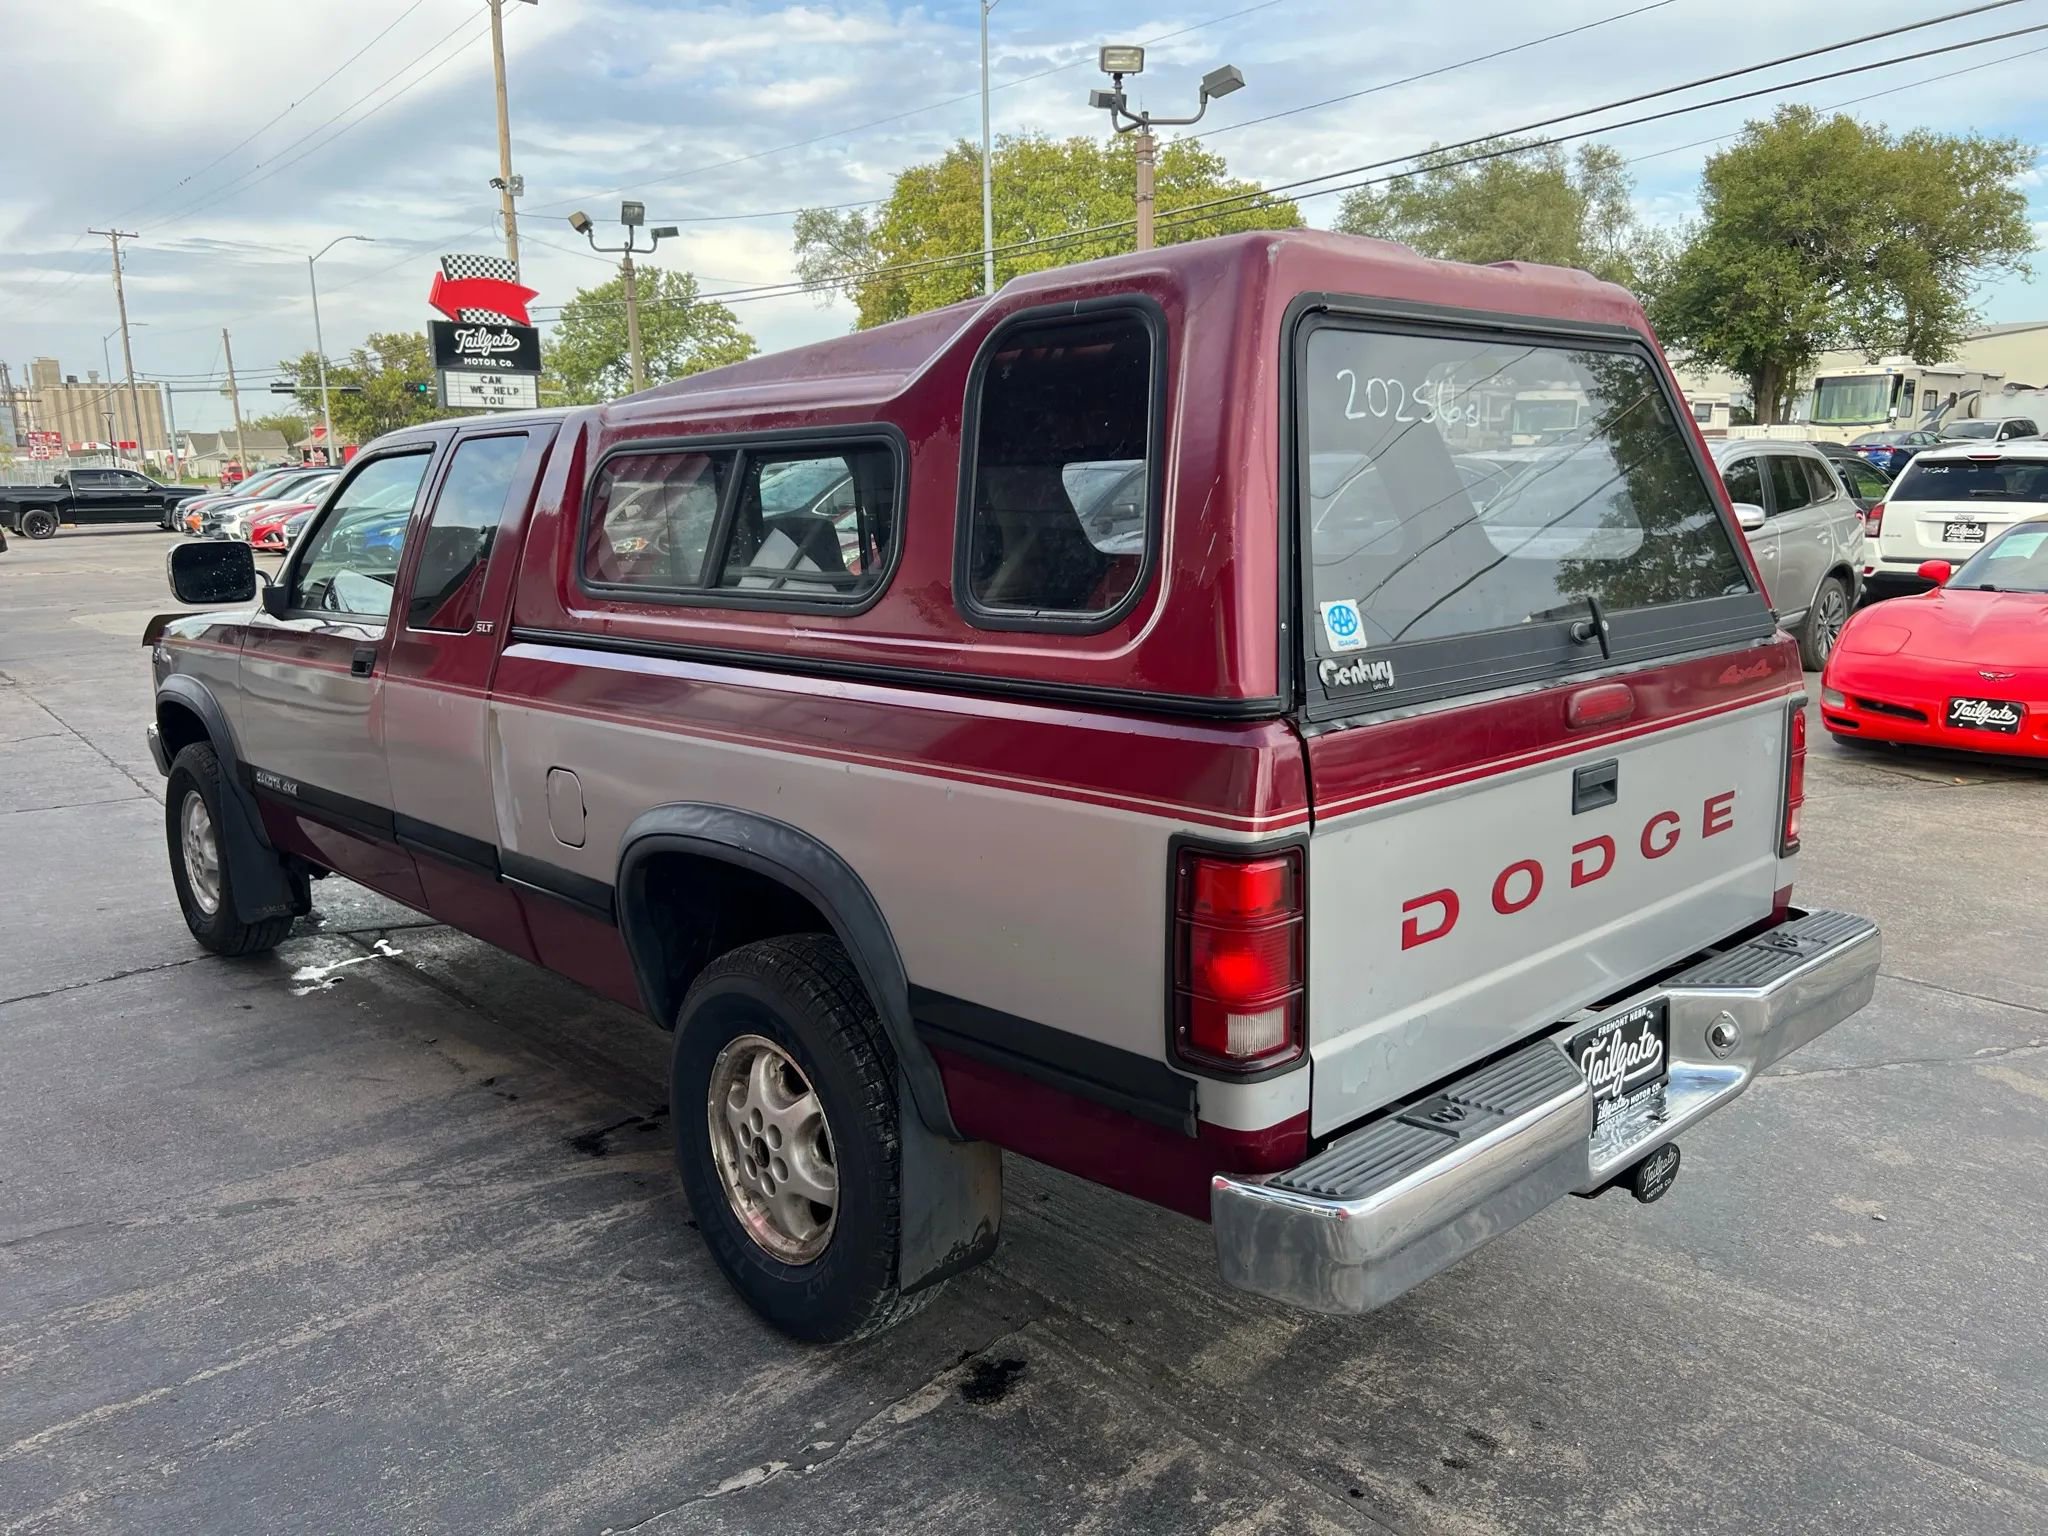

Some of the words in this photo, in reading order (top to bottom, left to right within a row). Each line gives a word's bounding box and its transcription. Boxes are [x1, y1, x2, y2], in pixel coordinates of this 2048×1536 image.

[454, 326, 521, 357] Tailgate
[464, 357, 497, 367] MOTOR
[470, 385, 484, 395] WE
[494, 386, 519, 396] HELP
[480, 375, 502, 385] CAN
[482, 395, 504, 406] YOU
[476, 623, 494, 633] SLT
[1319, 658, 1395, 687] Century
[1949, 699, 2018, 726] Tailgate
[256, 769, 282, 792] DAKOTA
[1401, 790, 1736, 951] DODGE
[1598, 1015, 1629, 1038] FREMONT
[1581, 1020, 1663, 1098] Tailgate
[1630, 1088, 1651, 1105] MOTOR
[1643, 1147, 1677, 1192] Tailgate
[1646, 1183, 1664, 1200] MOTOR
